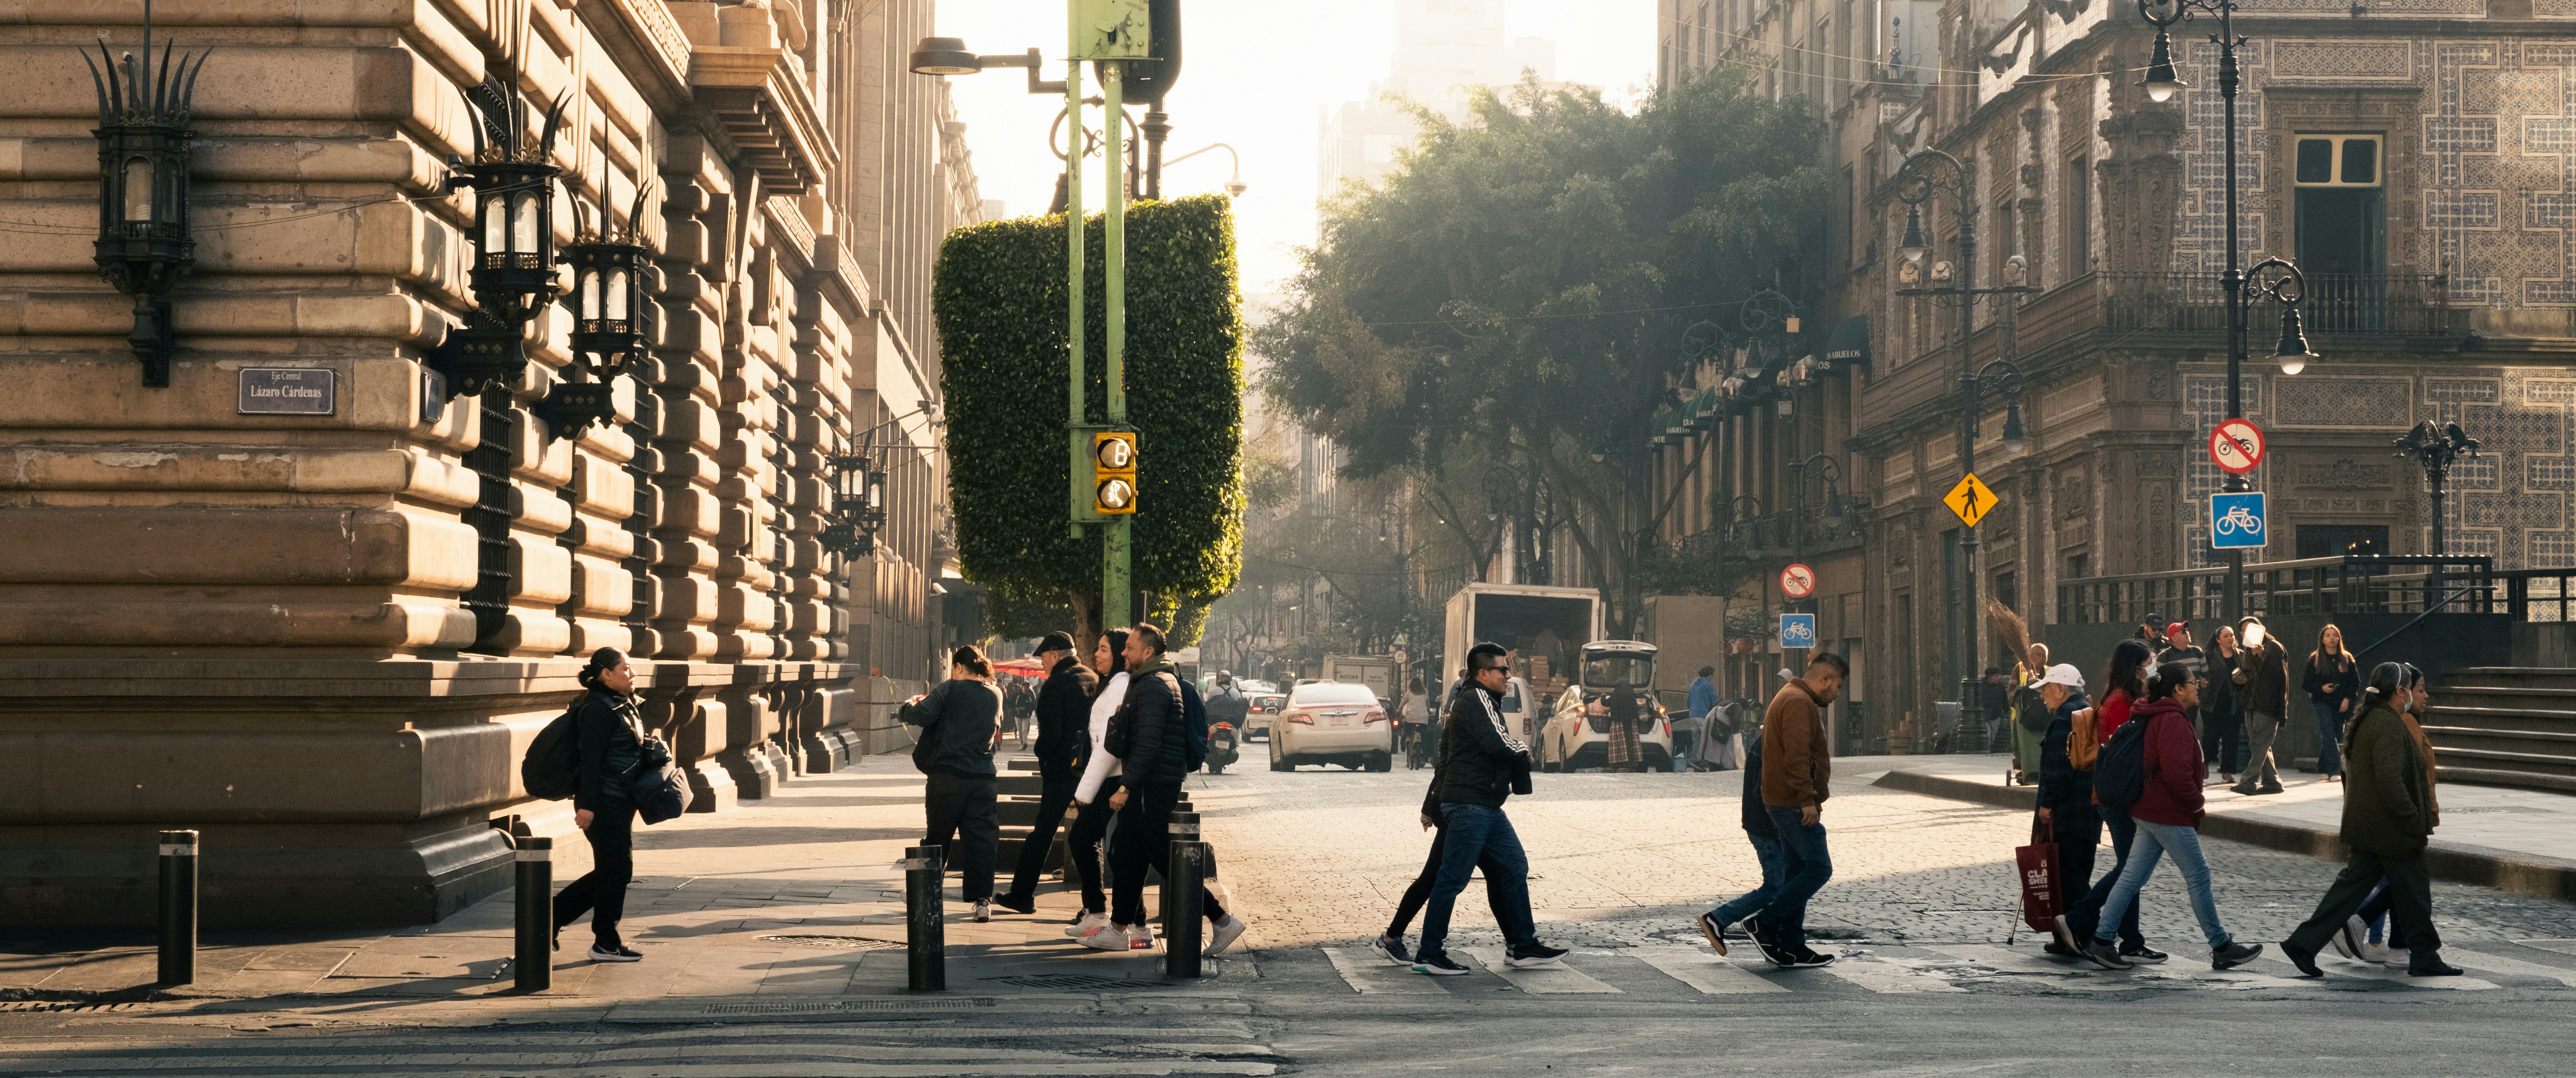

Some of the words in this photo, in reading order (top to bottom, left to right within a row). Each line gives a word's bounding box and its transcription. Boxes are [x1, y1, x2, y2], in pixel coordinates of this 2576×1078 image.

[1831, 350, 1860, 359] ABUELOS
[272, 371, 280, 382] Eje
[282, 372, 301, 380] Central
[251, 385, 280, 397] Lázaro
[282, 385, 322, 398] Cárdenas
[1115, 443, 1127, 465] 8
